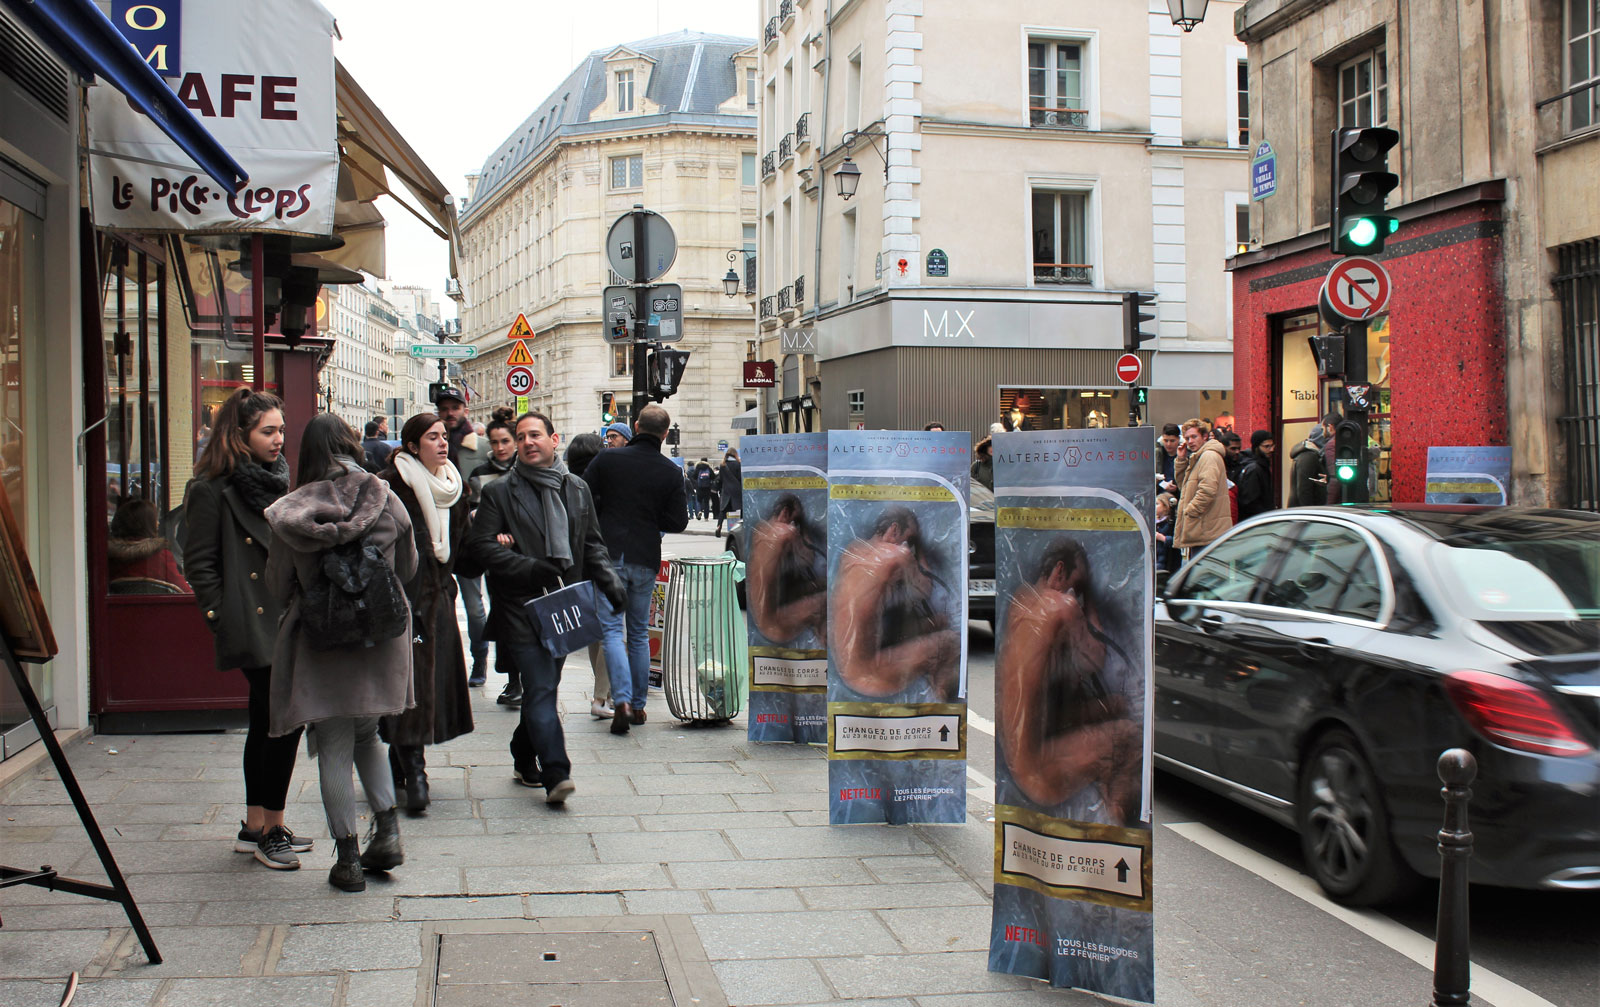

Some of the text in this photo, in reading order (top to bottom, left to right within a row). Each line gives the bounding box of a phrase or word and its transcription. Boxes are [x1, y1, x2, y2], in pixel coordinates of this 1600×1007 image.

[127, 72, 297, 120] AFE
[1258, 164, 1268, 174] RUE
[1260, 180, 1276, 192] TEMPLE
[113, 176, 133, 210] LE
[923, 309, 975, 338] M.X
[783, 332, 815, 348] M.X
[512, 375, 528, 388] 30
[833, 445, 966, 454] ALTERED CARBON
[998, 450, 1150, 463] ALTERED CARBON
[551, 604, 582, 635] GAP
[756, 713, 788, 723] NETFLIX
[842, 727, 885, 735] CHANGEZ
[905, 727, 932, 735] CORPS
[840, 788, 881, 801] NETFLIX
[922, 786, 954, 794] ÉPISODES
[1013, 841, 1105, 868] CHANGEZ DE CORPS
[1029, 856, 1040, 865] RUE
[1081, 865, 1105, 875] SICILE
[1058, 939, 1138, 958] TOUS LES ÉPISODES
[1077, 949, 1110, 962] FÉVRIER
